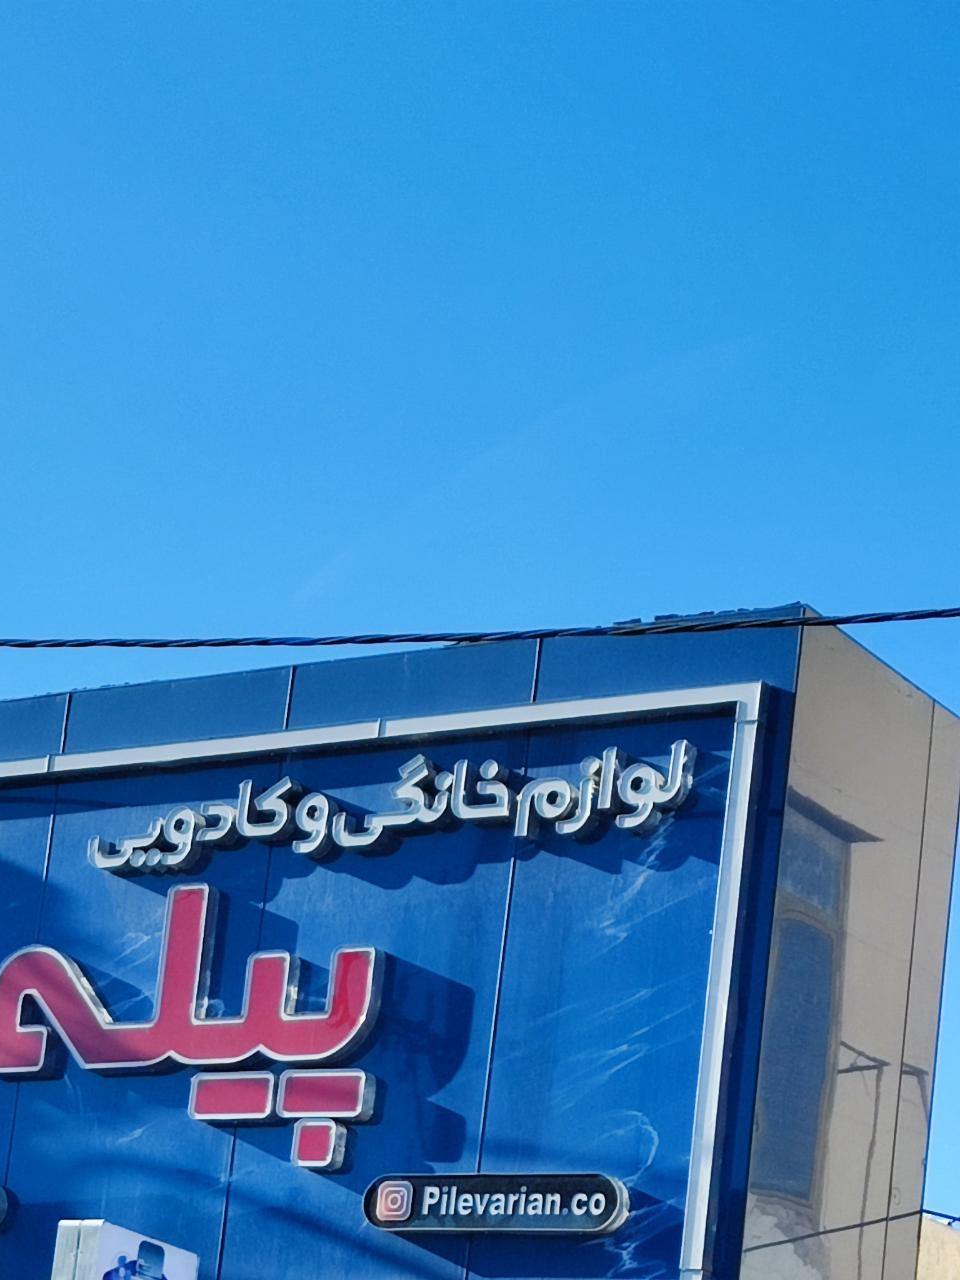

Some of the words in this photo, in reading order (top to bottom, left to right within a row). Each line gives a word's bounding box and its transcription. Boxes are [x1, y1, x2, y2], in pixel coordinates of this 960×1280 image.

[87, 776, 292, 868] کادویی
[332, 754, 510, 847] خانگی
[514, 739, 691, 837] لوازم
[422, 1185, 606, 1216] Pilevarian.co
